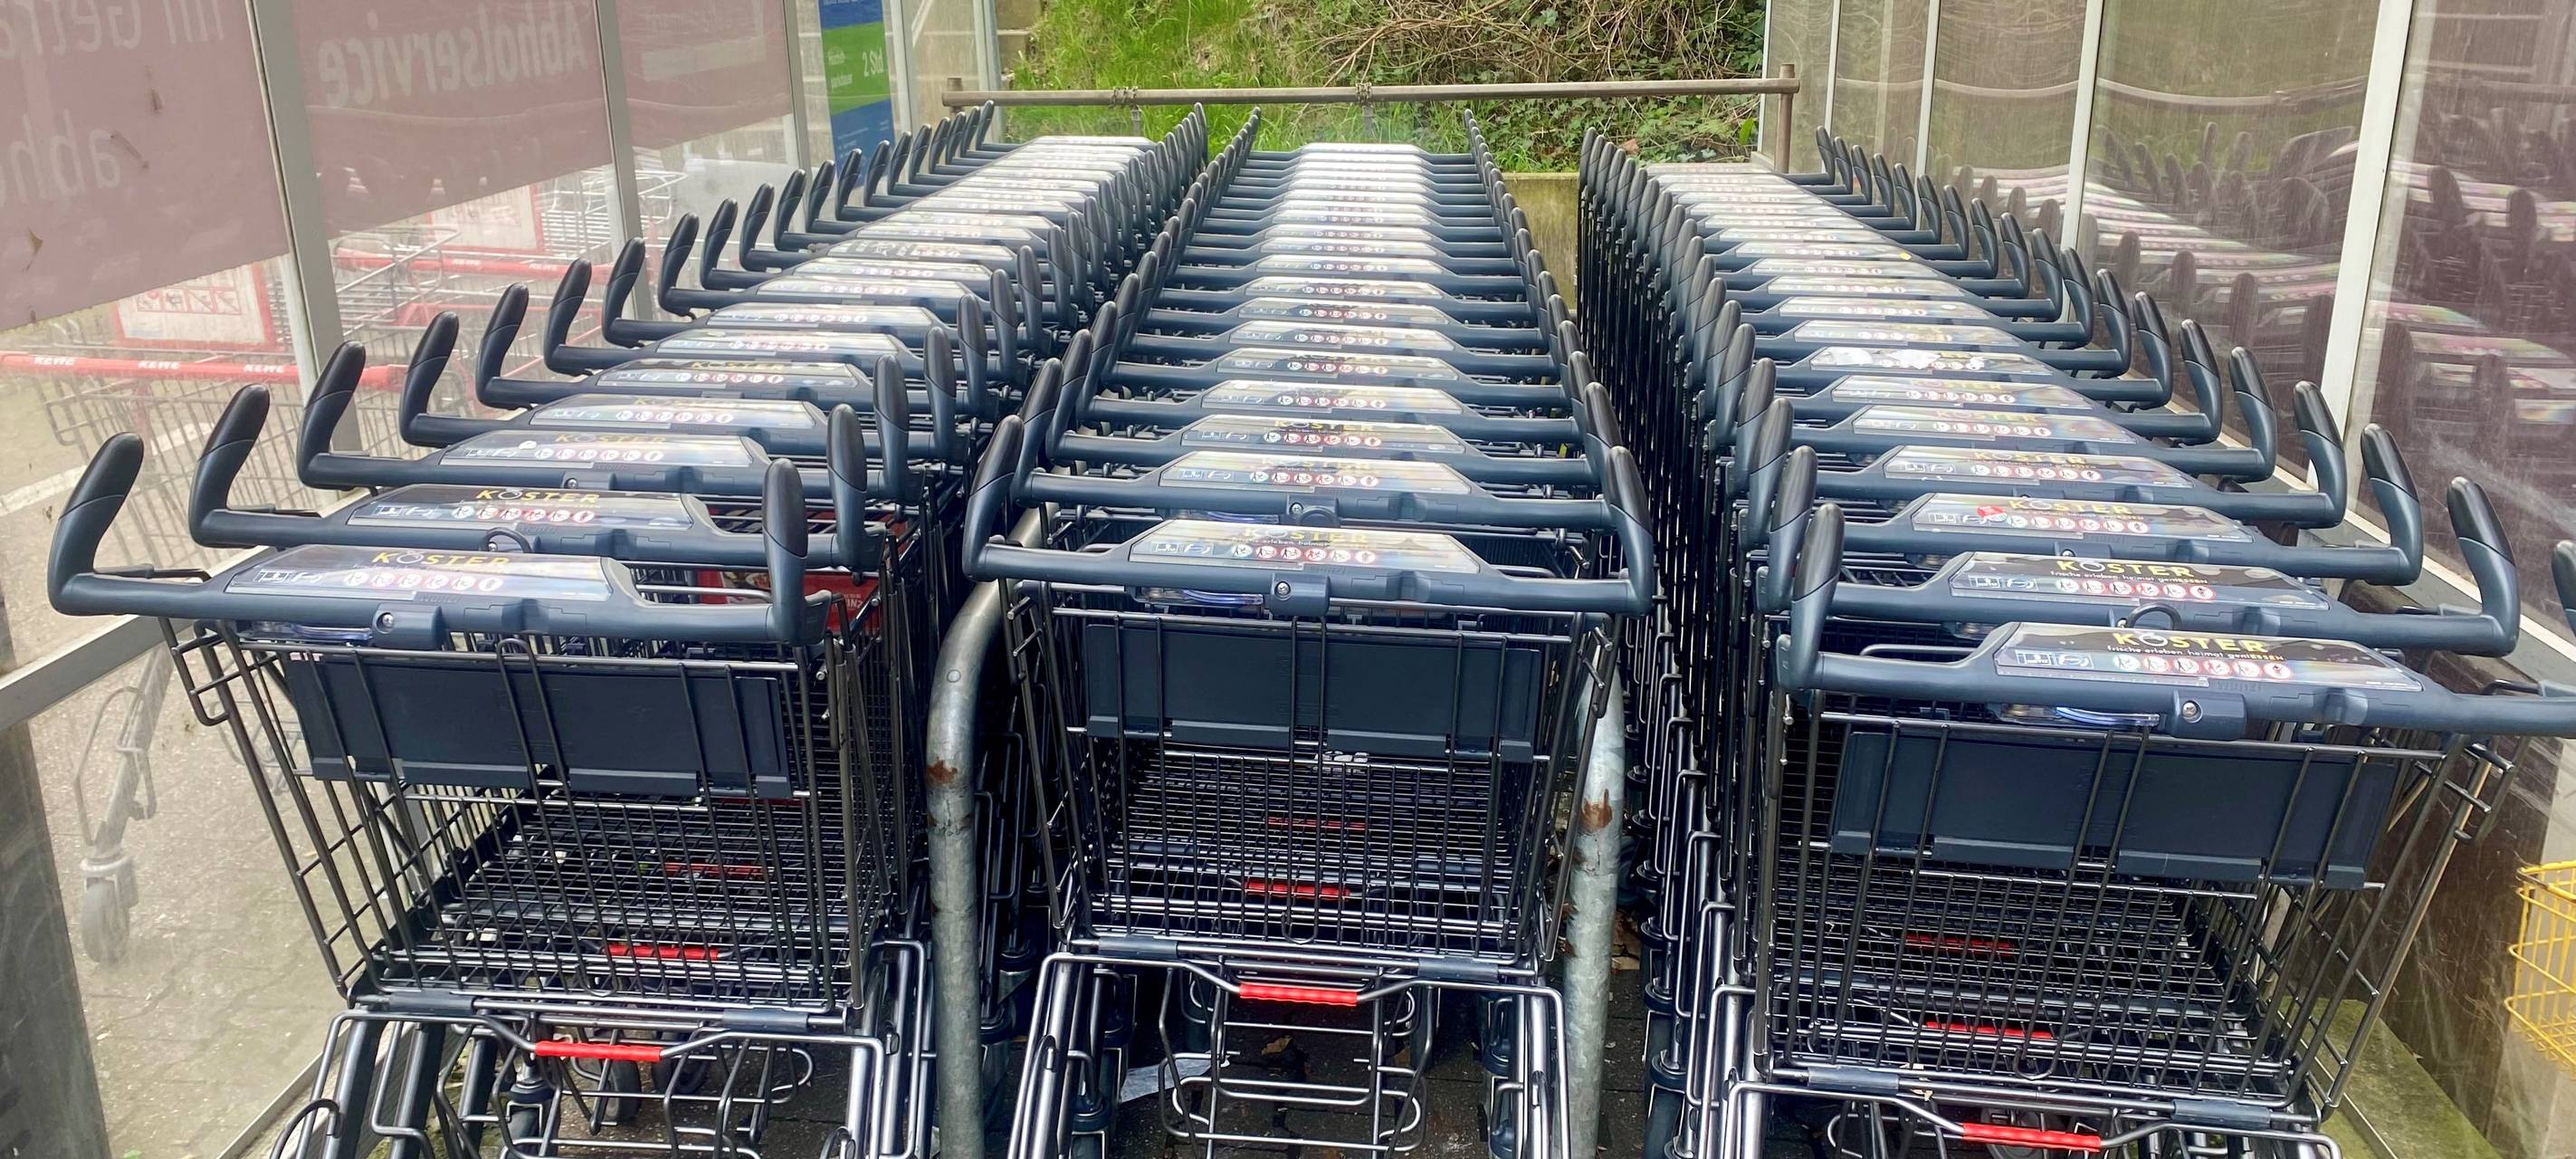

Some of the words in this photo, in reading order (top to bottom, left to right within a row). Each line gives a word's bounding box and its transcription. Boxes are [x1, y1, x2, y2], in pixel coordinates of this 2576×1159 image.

[2107, 645, 2142, 653] frische
[2144, 647, 2183, 656] erleben
[2187, 649, 2224, 657] heimat
